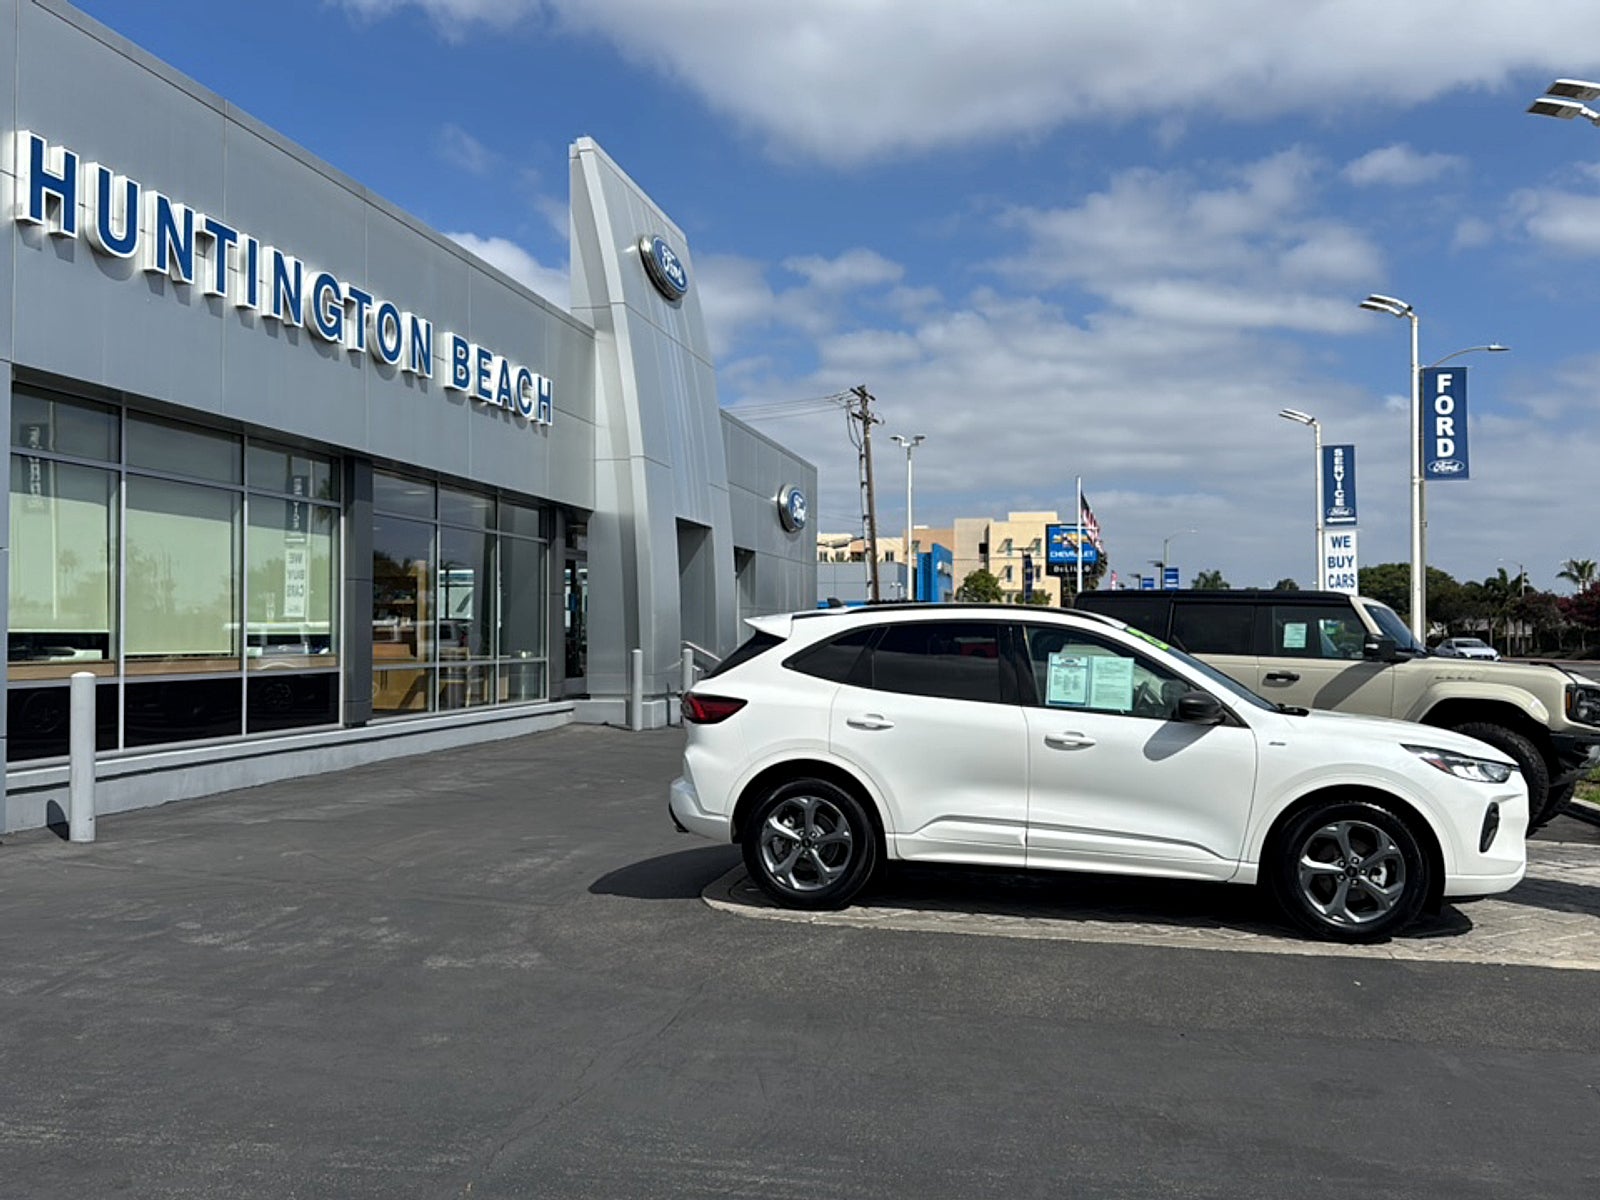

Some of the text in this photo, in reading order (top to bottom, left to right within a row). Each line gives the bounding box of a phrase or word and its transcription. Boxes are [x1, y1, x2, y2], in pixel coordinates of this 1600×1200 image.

[16, 131, 553, 425] HUNTINGTON BEACH
[660, 244, 685, 286] Ford
[1434, 373, 1455, 458] FORD
[1333, 448, 1345, 506] SERVICE
[1432, 460, 1461, 473] Ford
[1330, 535, 1352, 549] WE
[1327, 555, 1355, 569] BUY
[1328, 573, 1356, 588] CARS
